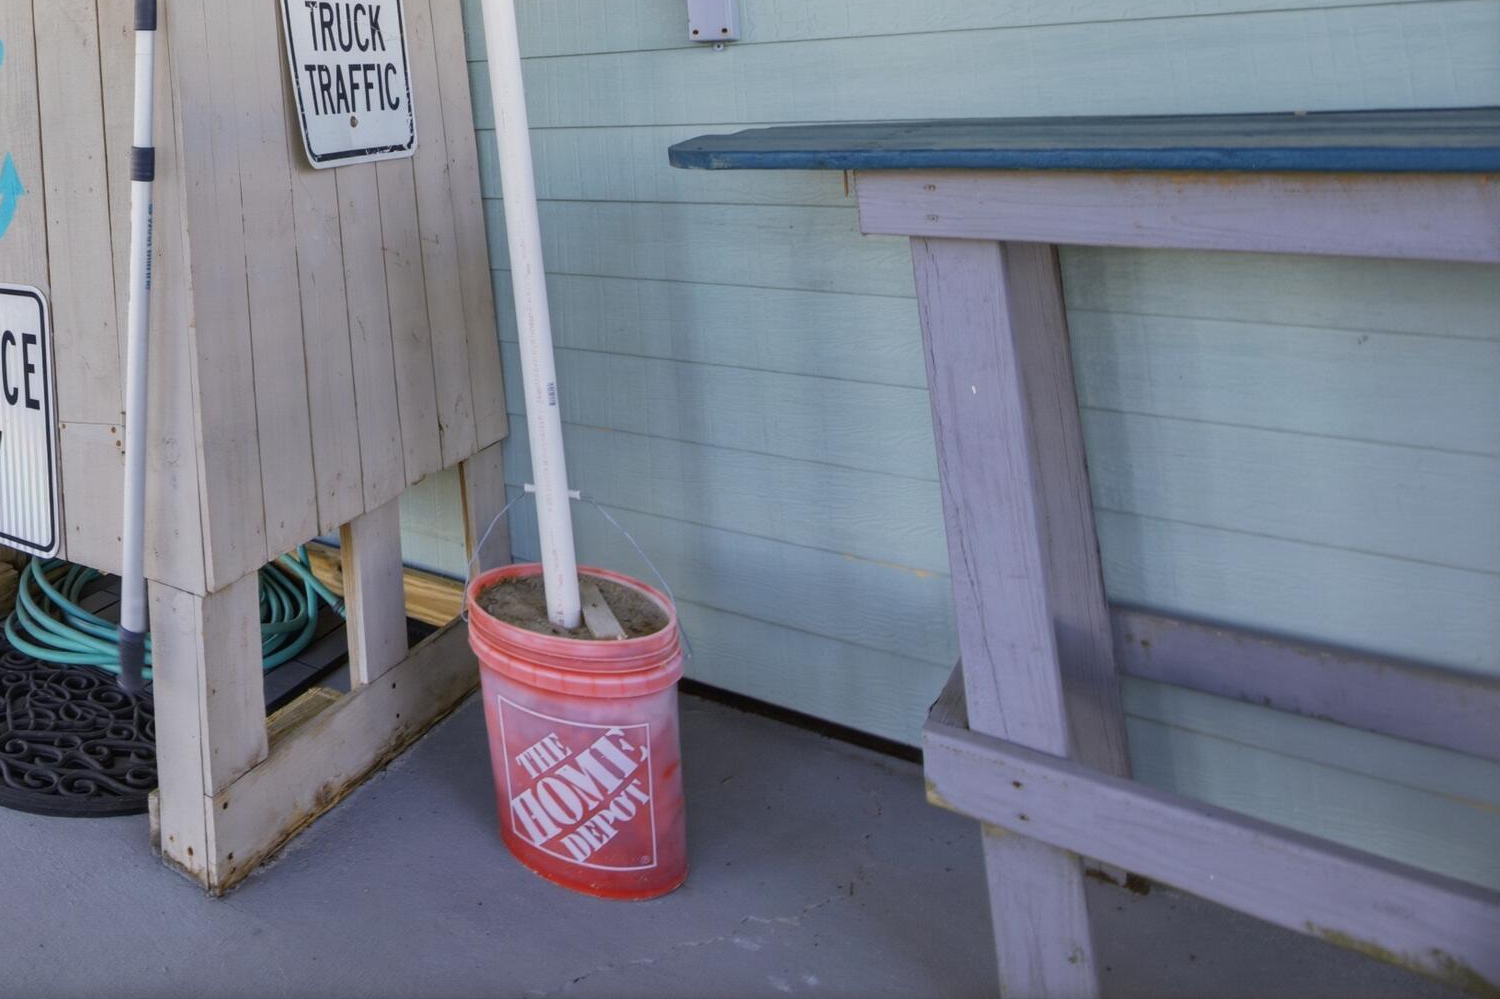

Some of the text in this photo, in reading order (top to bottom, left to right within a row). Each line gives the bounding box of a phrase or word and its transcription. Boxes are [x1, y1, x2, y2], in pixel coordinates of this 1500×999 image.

[304, 0, 387, 52] TRUCK
[304, 62, 401, 116] TRAFFIC
[515, 732, 573, 780] THE
[510, 727, 650, 848] HOME
[560, 779, 651, 864] DEPOT
